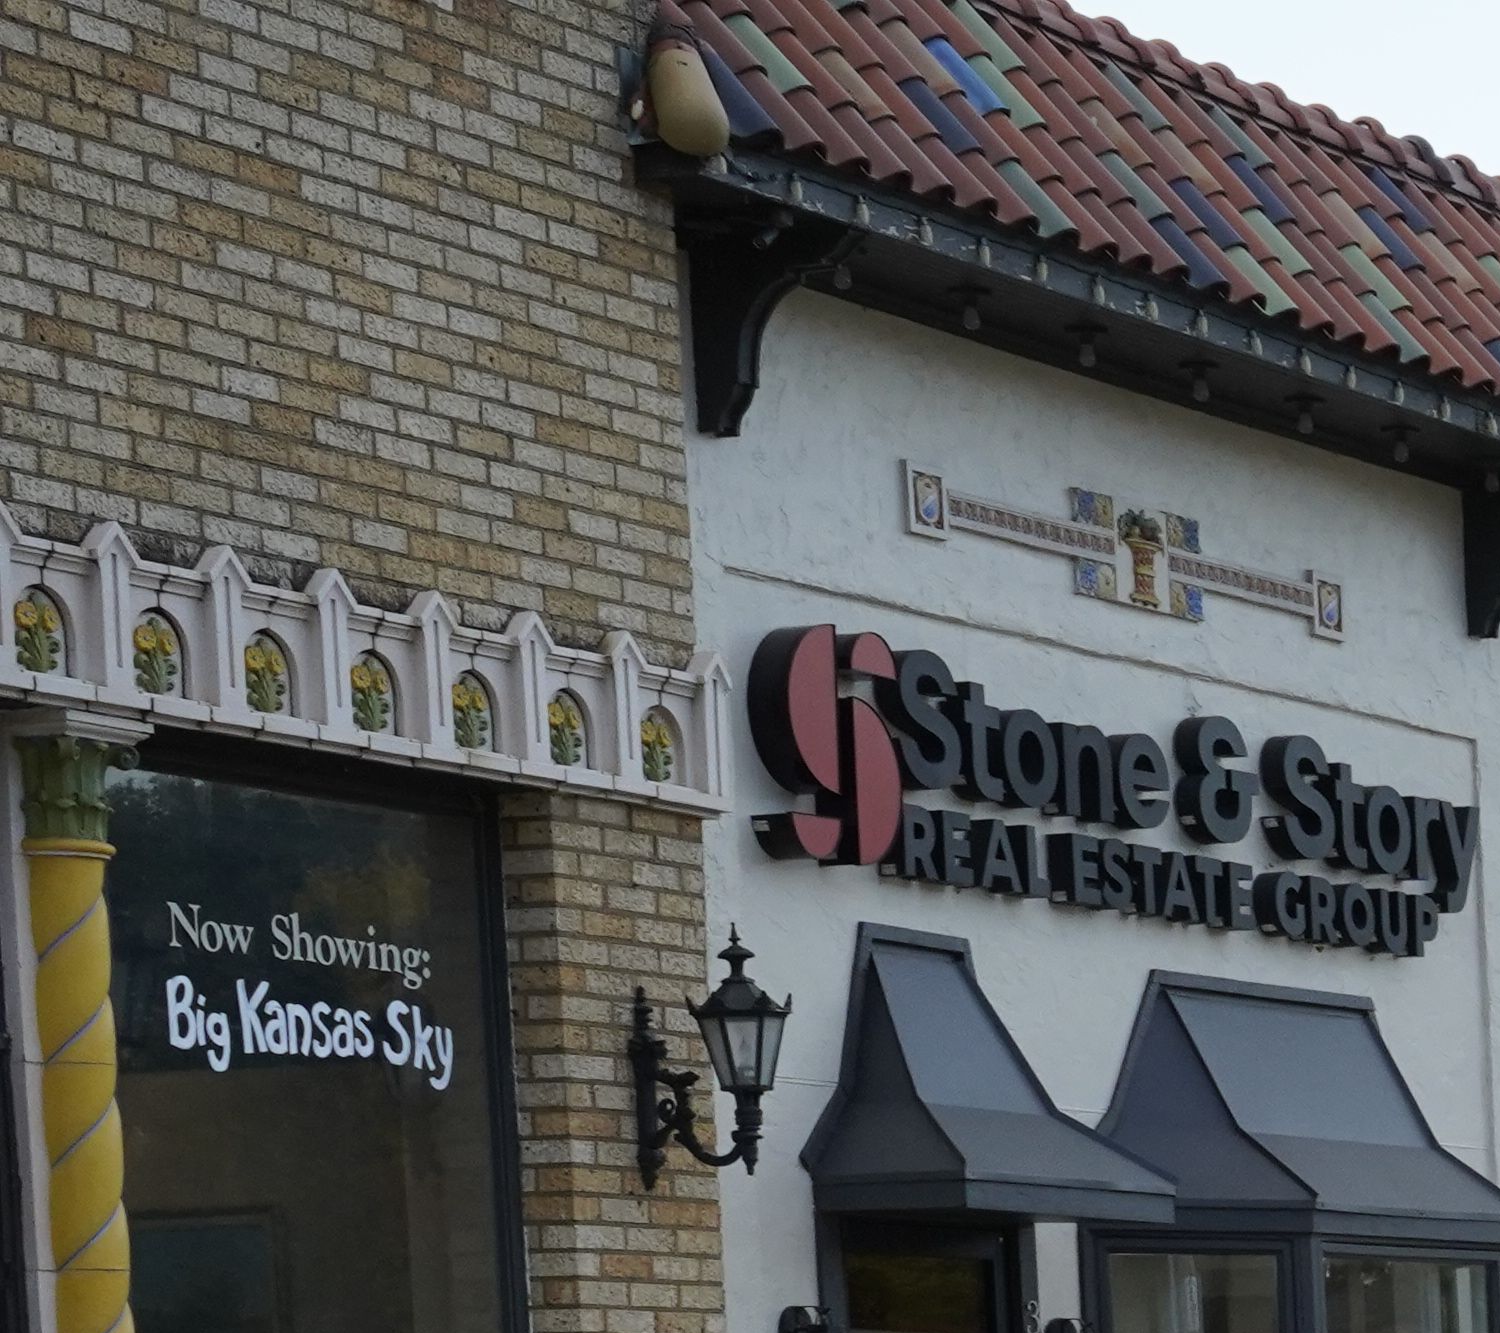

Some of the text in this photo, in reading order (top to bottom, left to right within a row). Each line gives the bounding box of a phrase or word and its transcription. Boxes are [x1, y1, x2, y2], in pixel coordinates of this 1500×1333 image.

[893, 648, 1480, 913] Stone & Story
[166, 901, 431, 990] Now Showing:
[886, 804, 1440, 957] REAL ESTATE GROUP
[165, 974, 454, 1091] Big Kansas Sky
